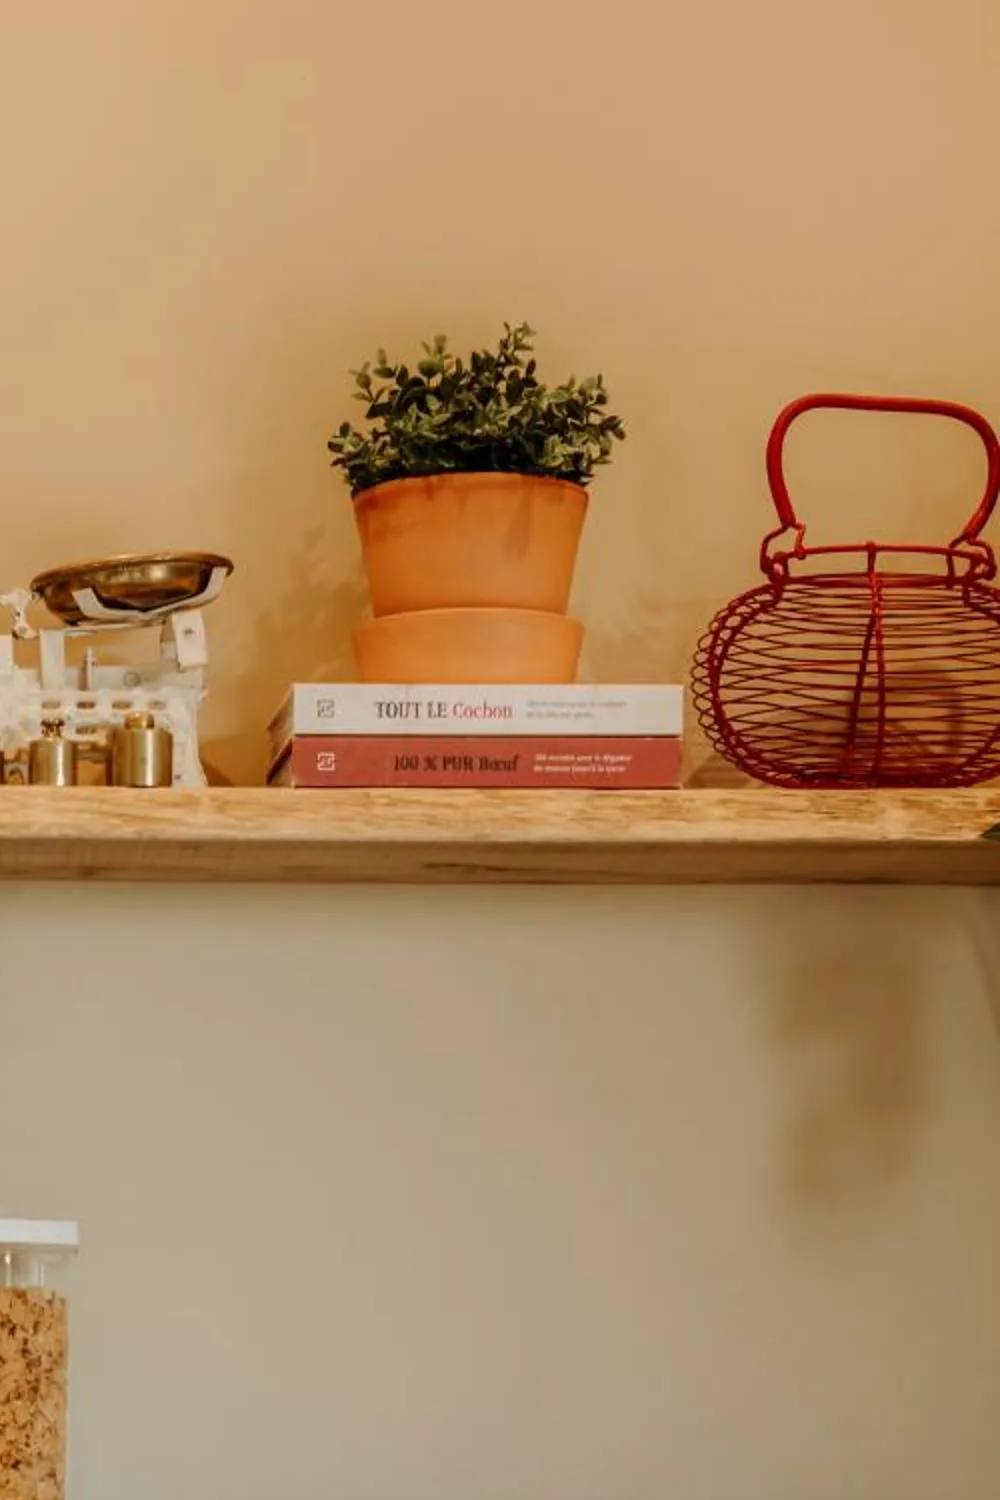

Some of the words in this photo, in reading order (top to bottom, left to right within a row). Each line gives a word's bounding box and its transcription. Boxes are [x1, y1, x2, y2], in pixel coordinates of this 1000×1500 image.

[376, 701, 421, 719] TOUT
[428, 701, 447, 719] LE
[452, 699, 513, 719] Cochon
[394, 755, 419, 771] 100
[443, 755, 474, 771] PUR
